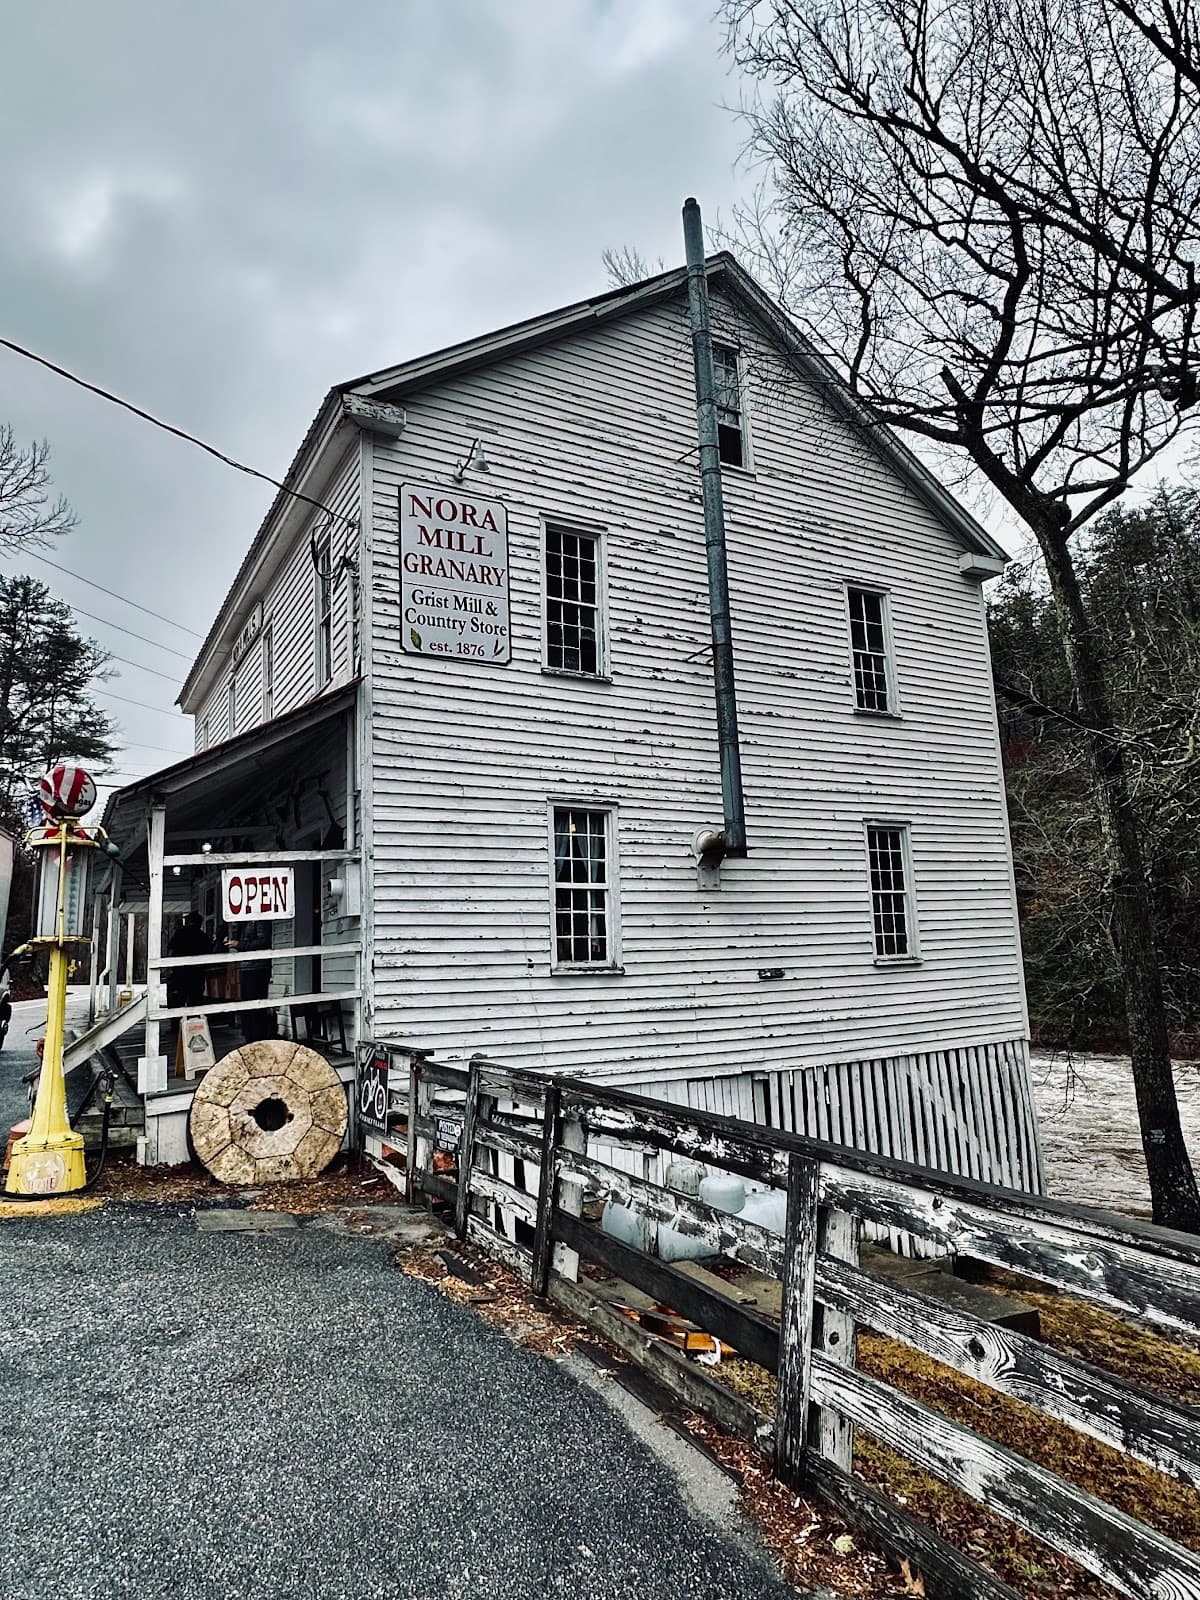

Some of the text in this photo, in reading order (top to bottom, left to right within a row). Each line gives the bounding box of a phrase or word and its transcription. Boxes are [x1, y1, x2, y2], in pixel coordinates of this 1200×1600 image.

[408, 494, 500, 534] NORA
[417, 524, 493, 557] MILL
[403, 552, 506, 587] GRANARY
[411, 589, 498, 617] Grist Mill &
[404, 608, 508, 636] Country Store
[429, 640, 485, 657] est. 1876
[229, 876, 288, 915] OPEN
